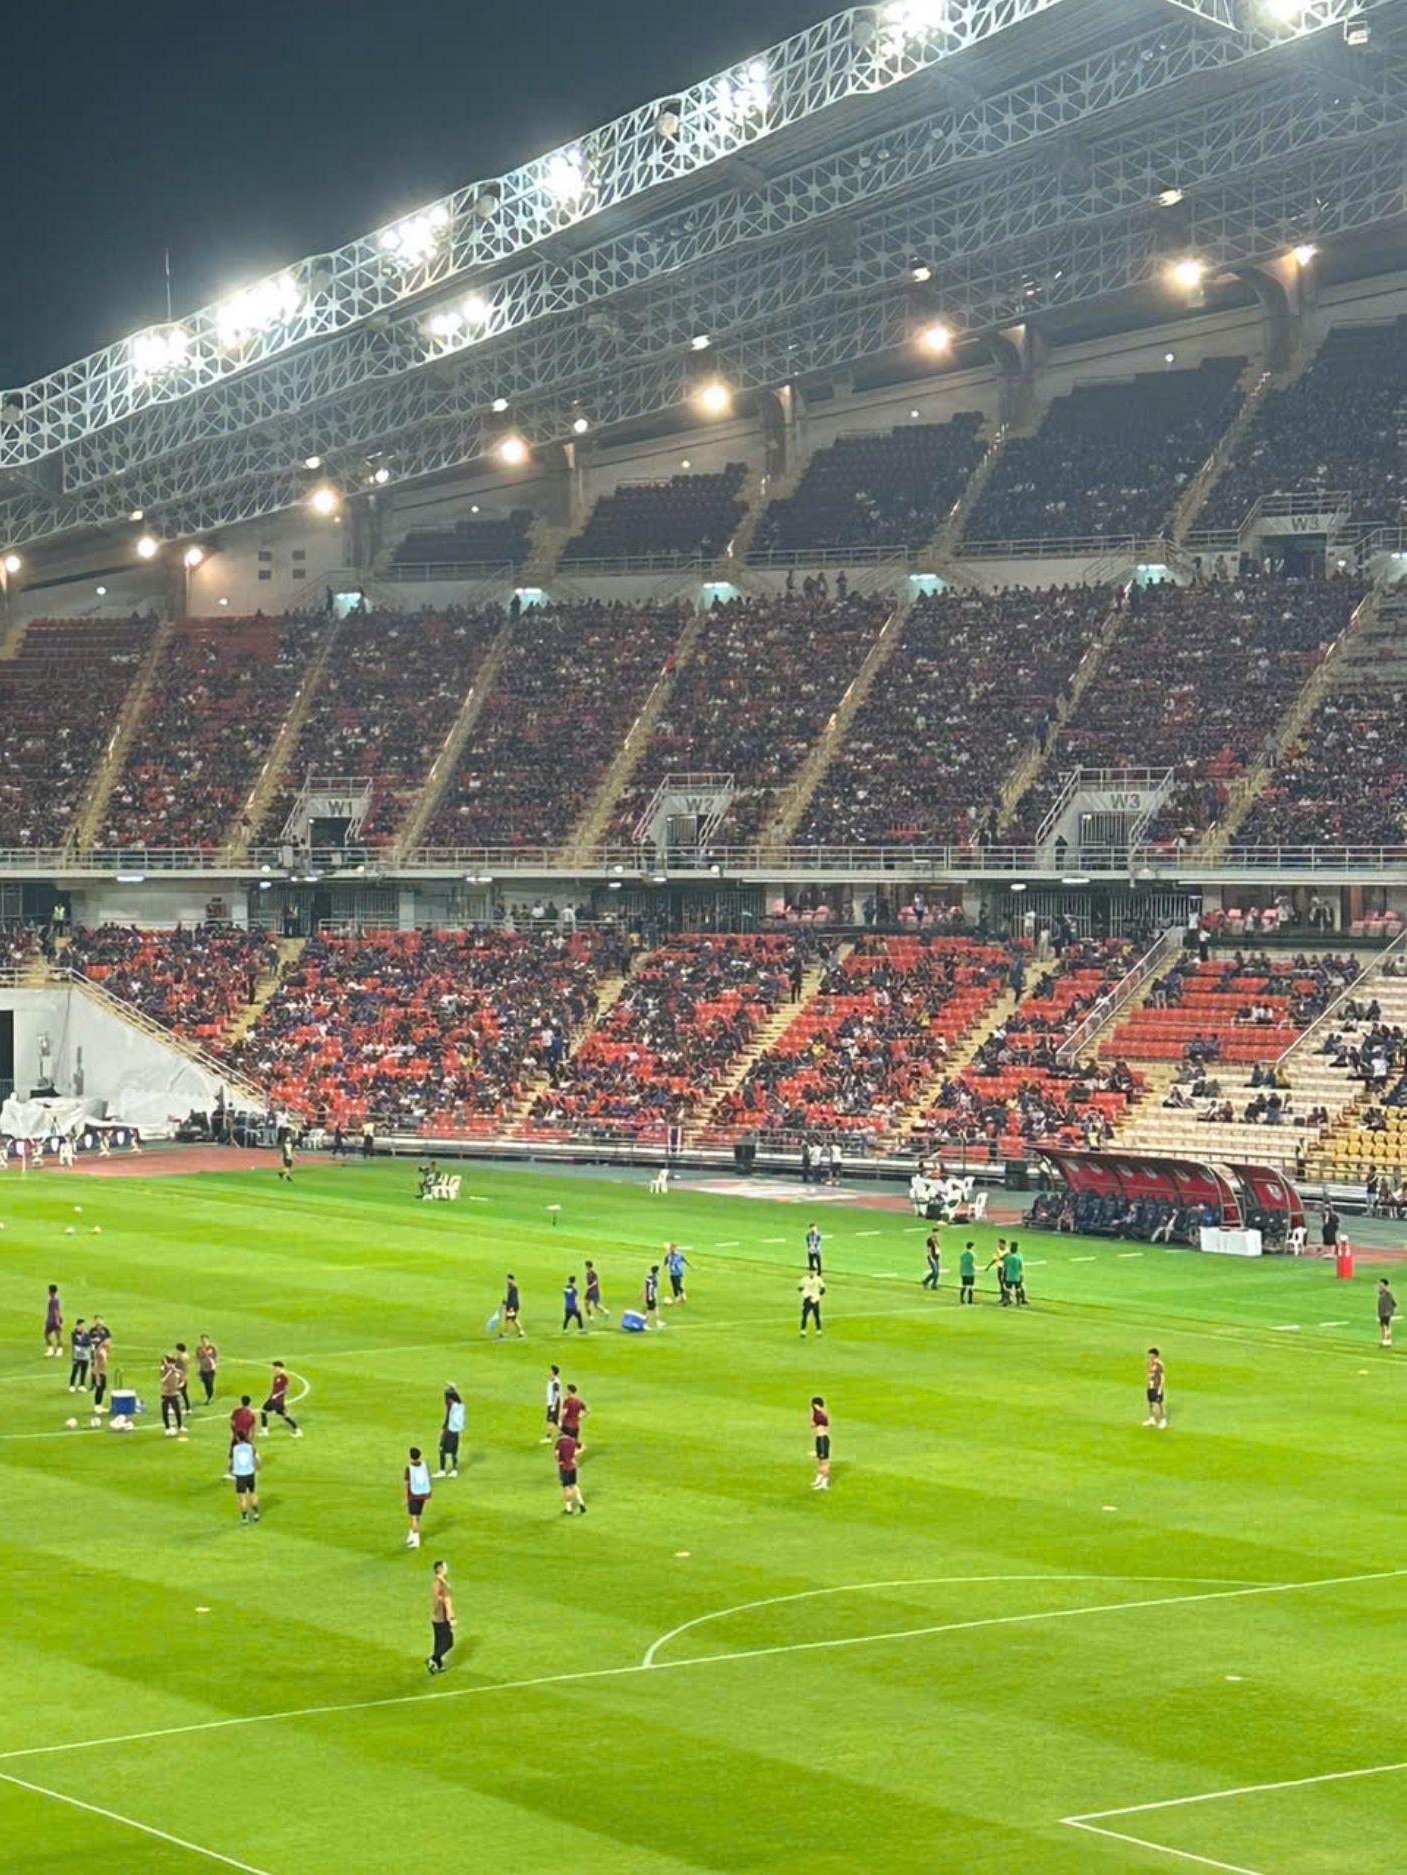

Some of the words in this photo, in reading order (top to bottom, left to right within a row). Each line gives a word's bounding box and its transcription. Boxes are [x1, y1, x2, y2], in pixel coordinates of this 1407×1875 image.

[328, 801, 353, 816] W1
[686, 798, 715, 813] W2
[1110, 793, 1140, 809] W3
